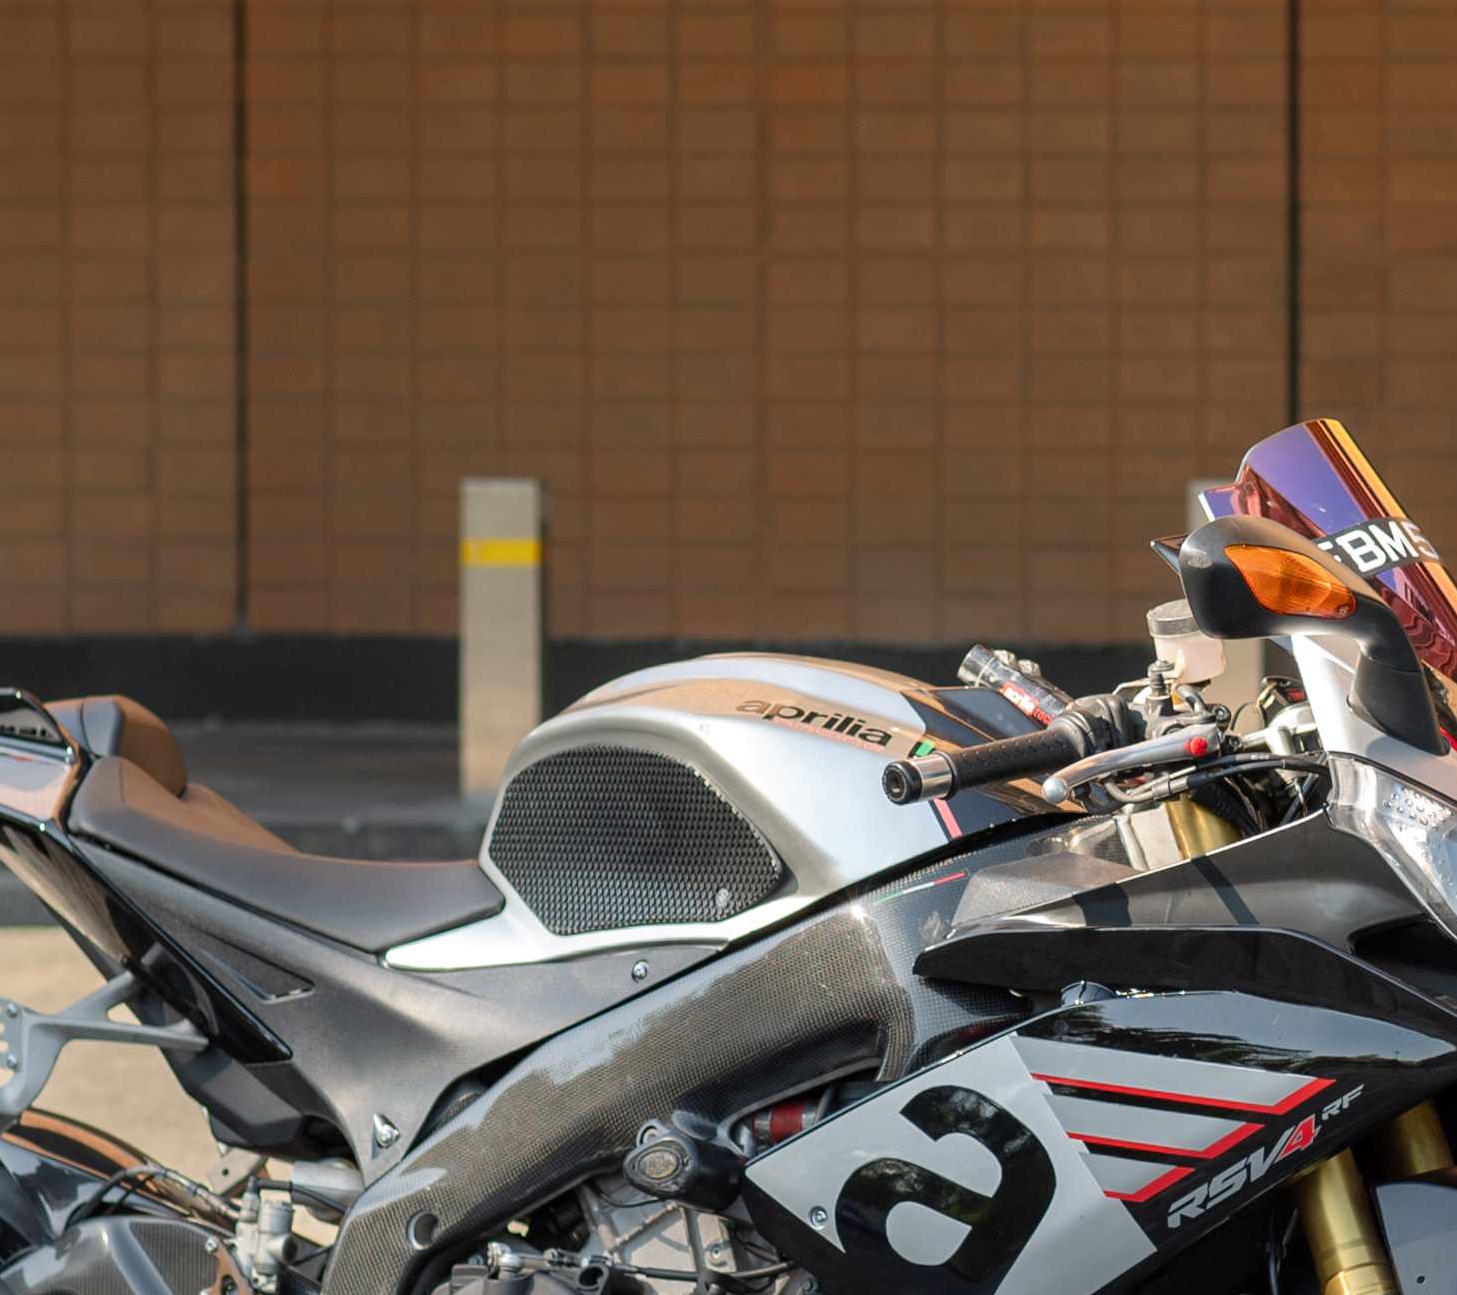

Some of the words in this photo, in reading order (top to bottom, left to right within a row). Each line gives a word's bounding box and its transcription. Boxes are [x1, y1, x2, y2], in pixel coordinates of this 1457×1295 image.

[736, 700, 893, 747] aprilia
[1167, 1113, 1322, 1229] RSV4
[1321, 1083, 1365, 1121] RF
